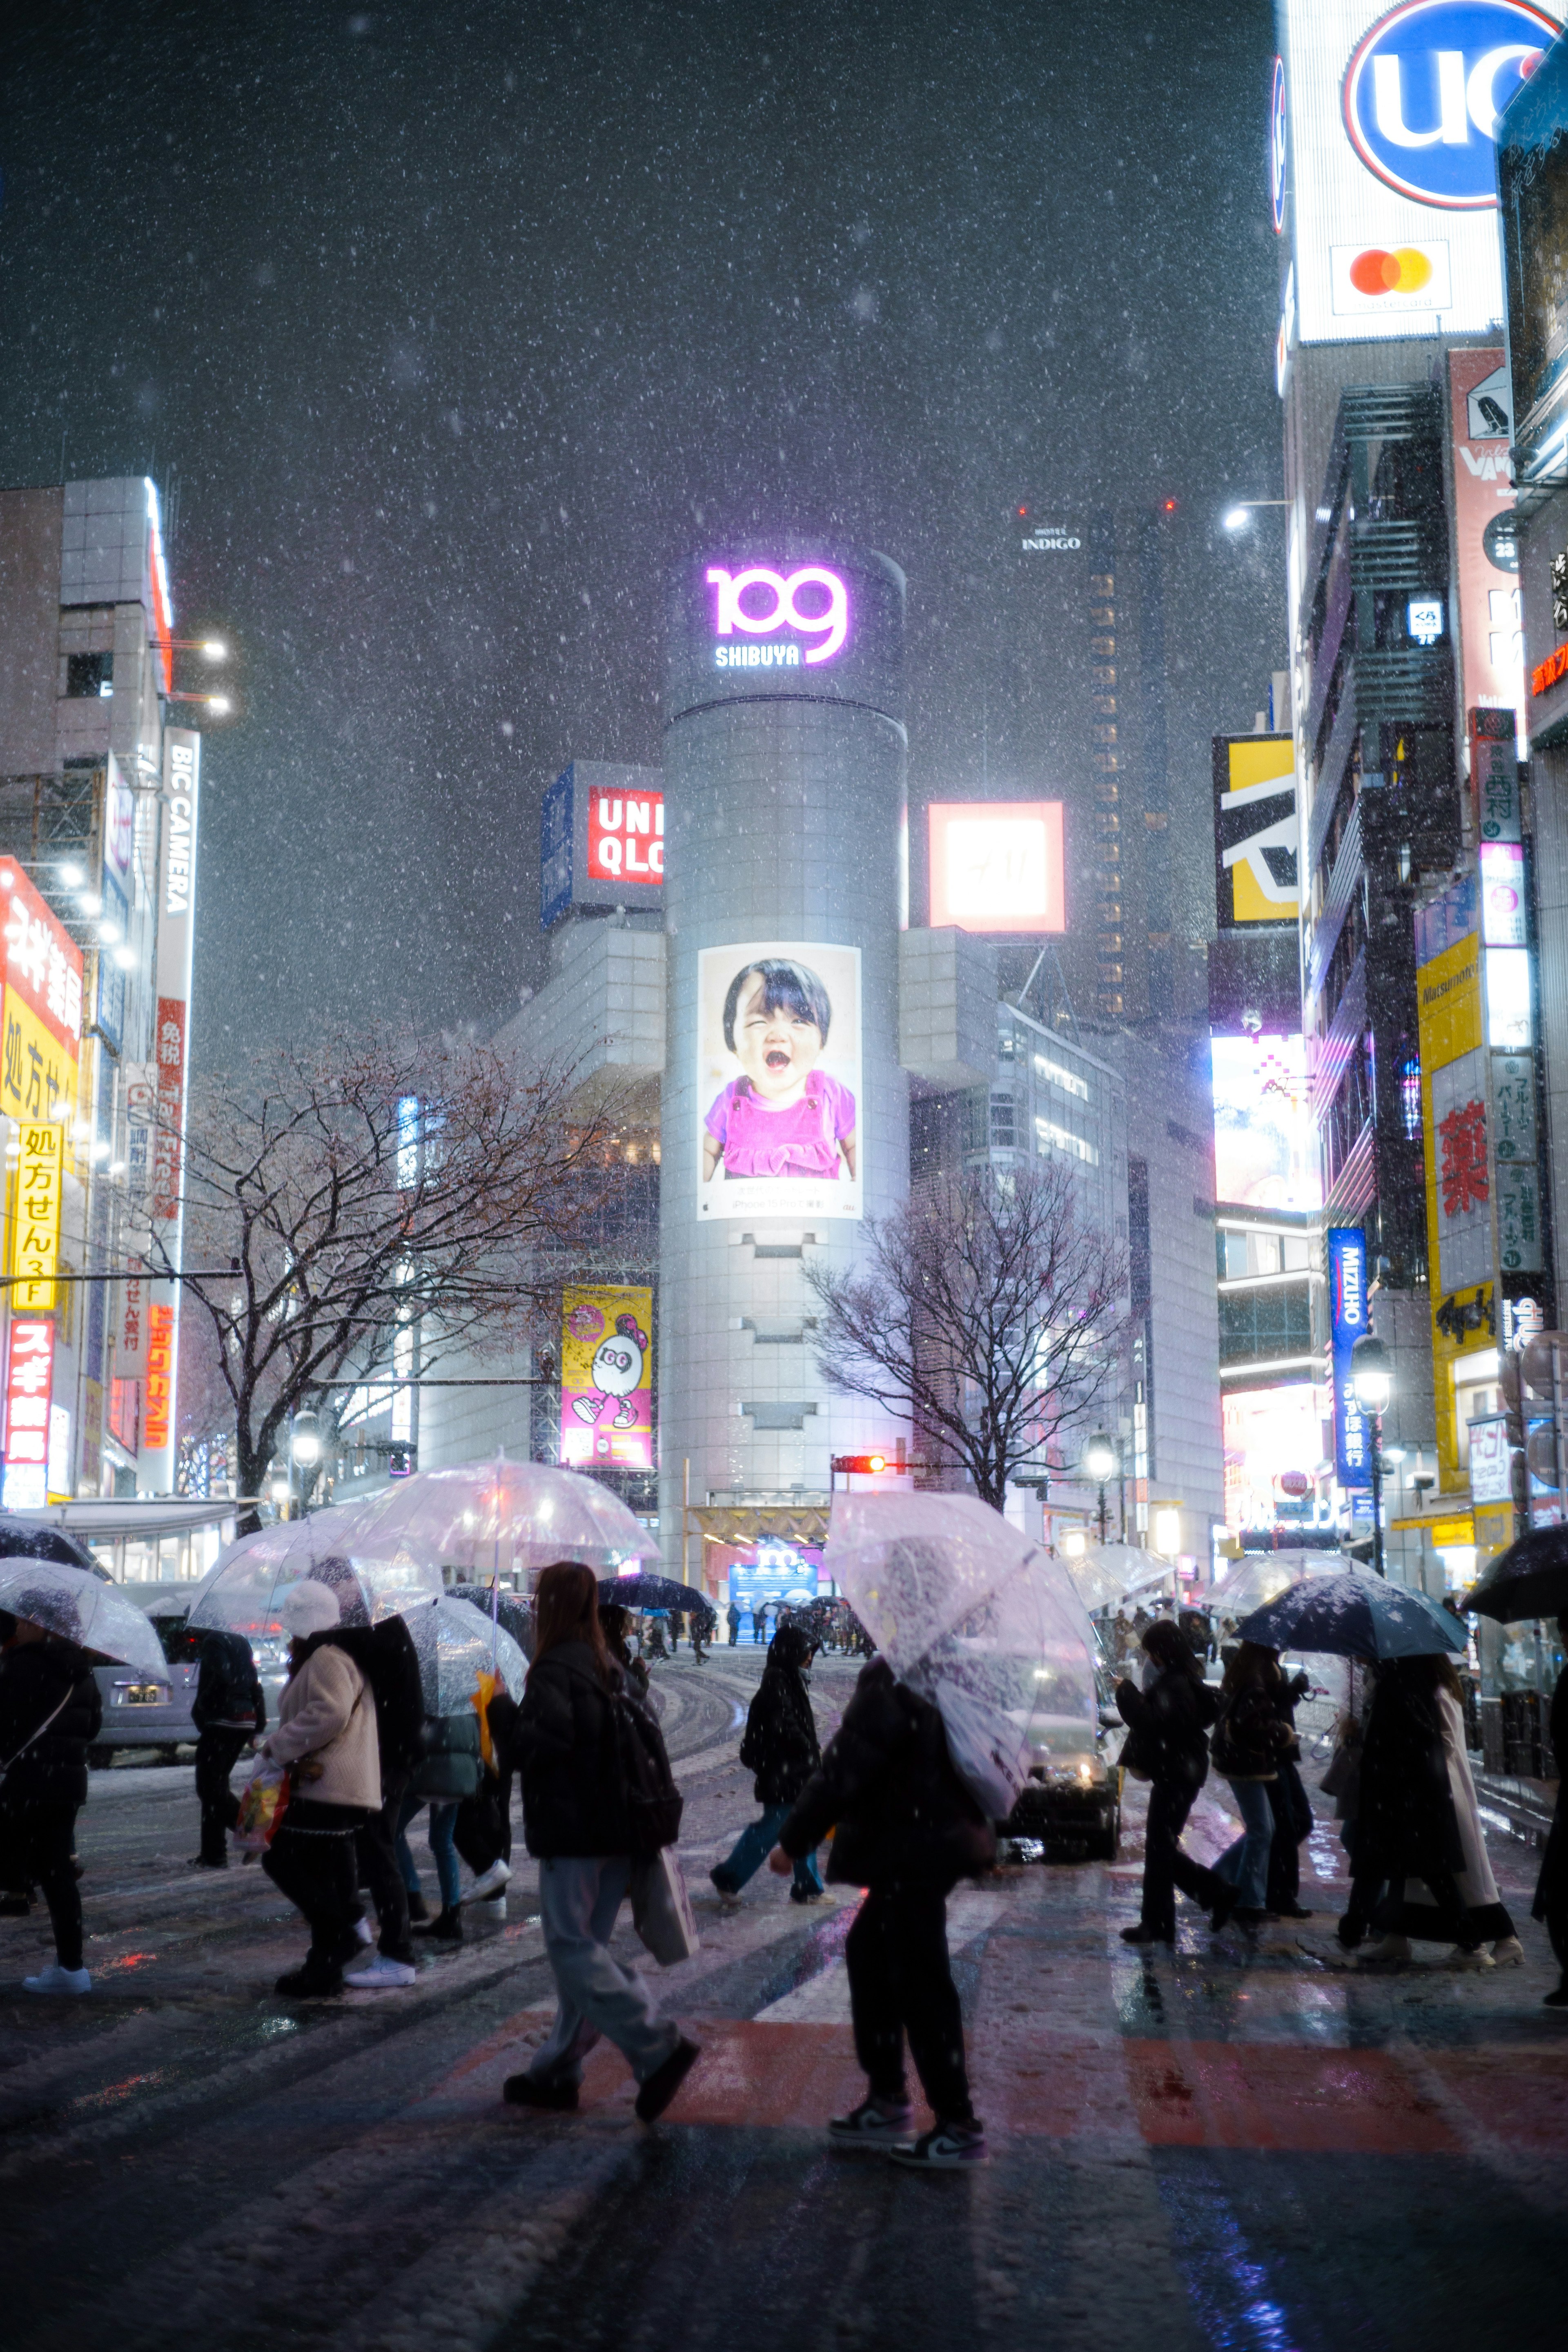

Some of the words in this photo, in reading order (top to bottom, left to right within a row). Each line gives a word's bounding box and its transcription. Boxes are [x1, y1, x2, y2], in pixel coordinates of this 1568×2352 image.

[1022, 537, 1081, 550] INDIGO
[706, 568, 847, 664] 109
[715, 645, 799, 666] SHIBUYA
[171, 745, 193, 792] BIC
[599, 798, 664, 835] UNI
[167, 797, 191, 914] CAMERA
[161, 1021, 181, 1065] 免税
[1440, 1100, 1490, 1219] 薬
[22, 1130, 56, 1252] 処方せん
[1342, 1247, 1360, 1325] MIZUHO
